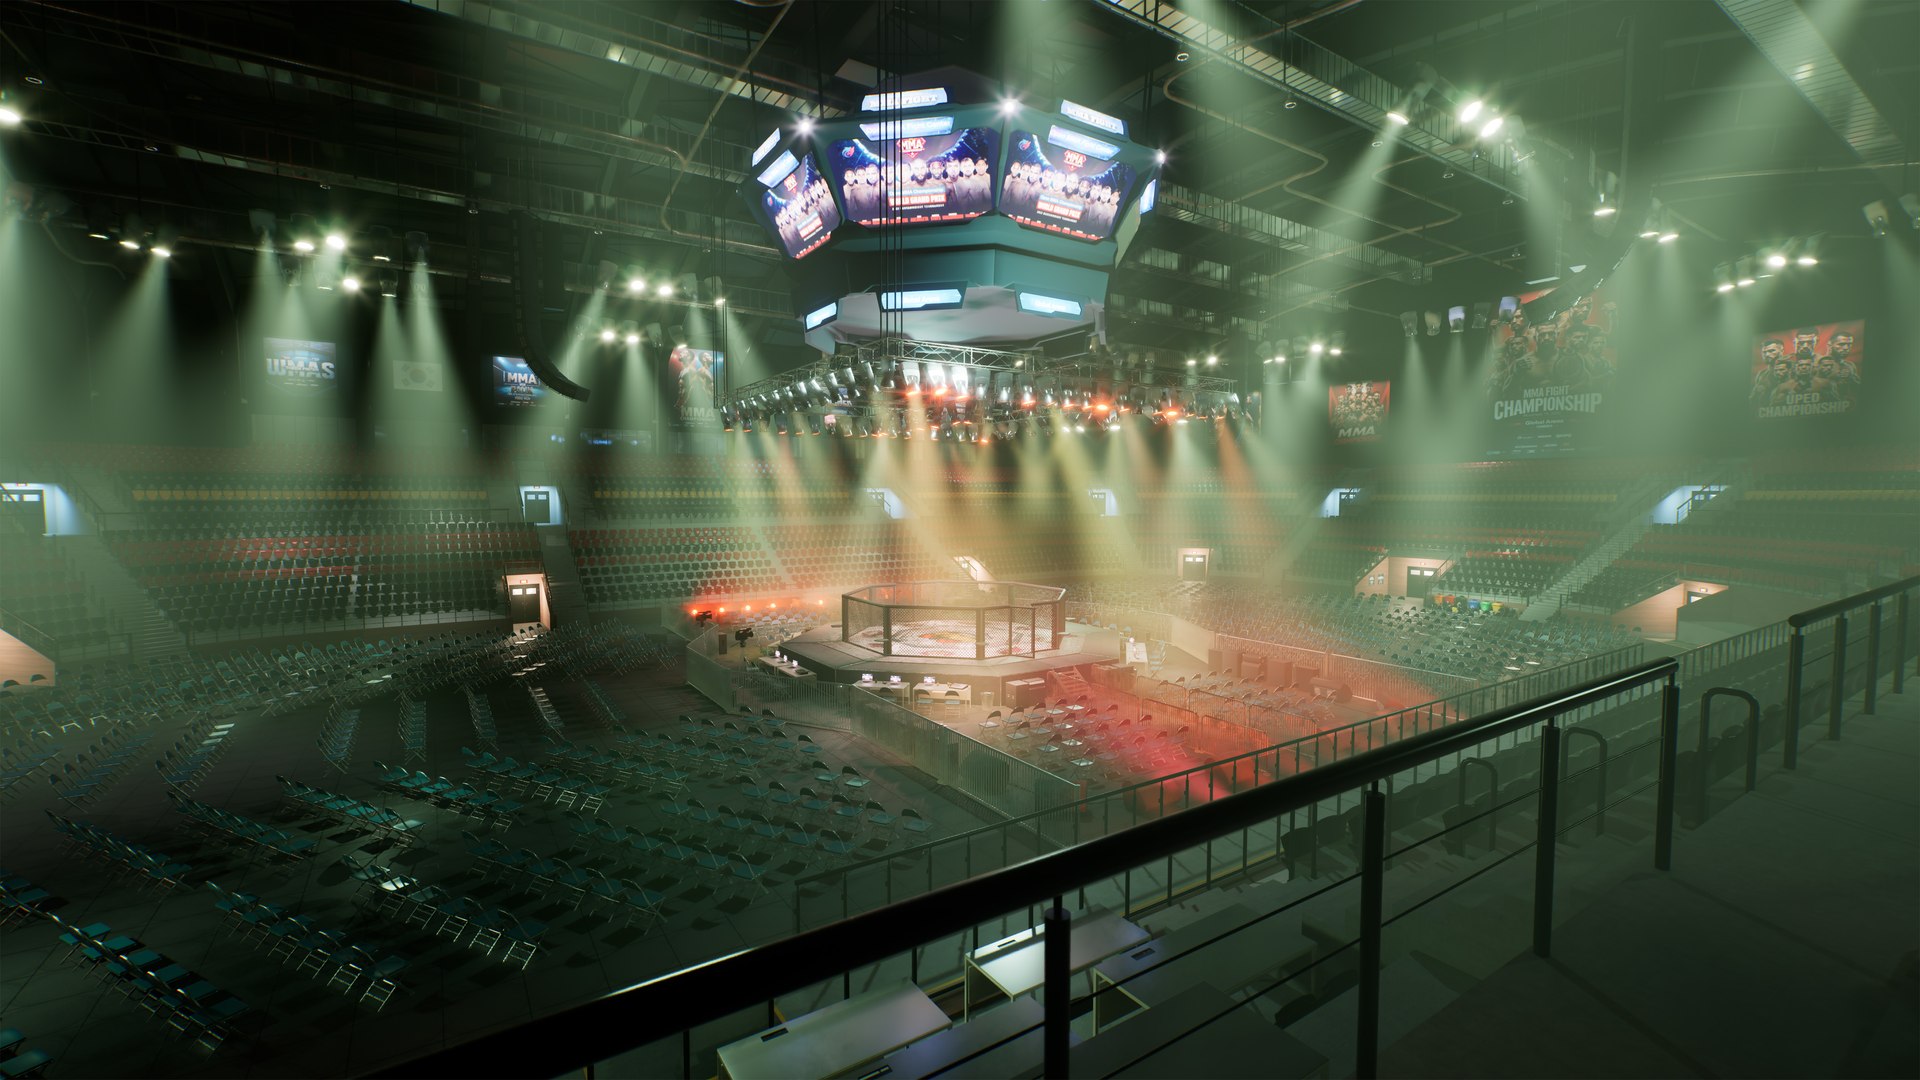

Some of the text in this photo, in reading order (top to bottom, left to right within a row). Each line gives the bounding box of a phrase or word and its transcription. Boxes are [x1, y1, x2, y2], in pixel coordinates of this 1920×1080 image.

[901, 139, 923, 151] MMA
[1065, 151, 1084, 166] MMA
[507, 372, 538, 385] MMA
[1523, 385, 1569, 398] MMA FIGHT
[681, 407, 714, 417] MMA
[1494, 393, 1602, 420] CHAMPIONSHIP
[1758, 401, 1850, 418] CHAMPIONSHIP
[1338, 425, 1376, 438] MMA
